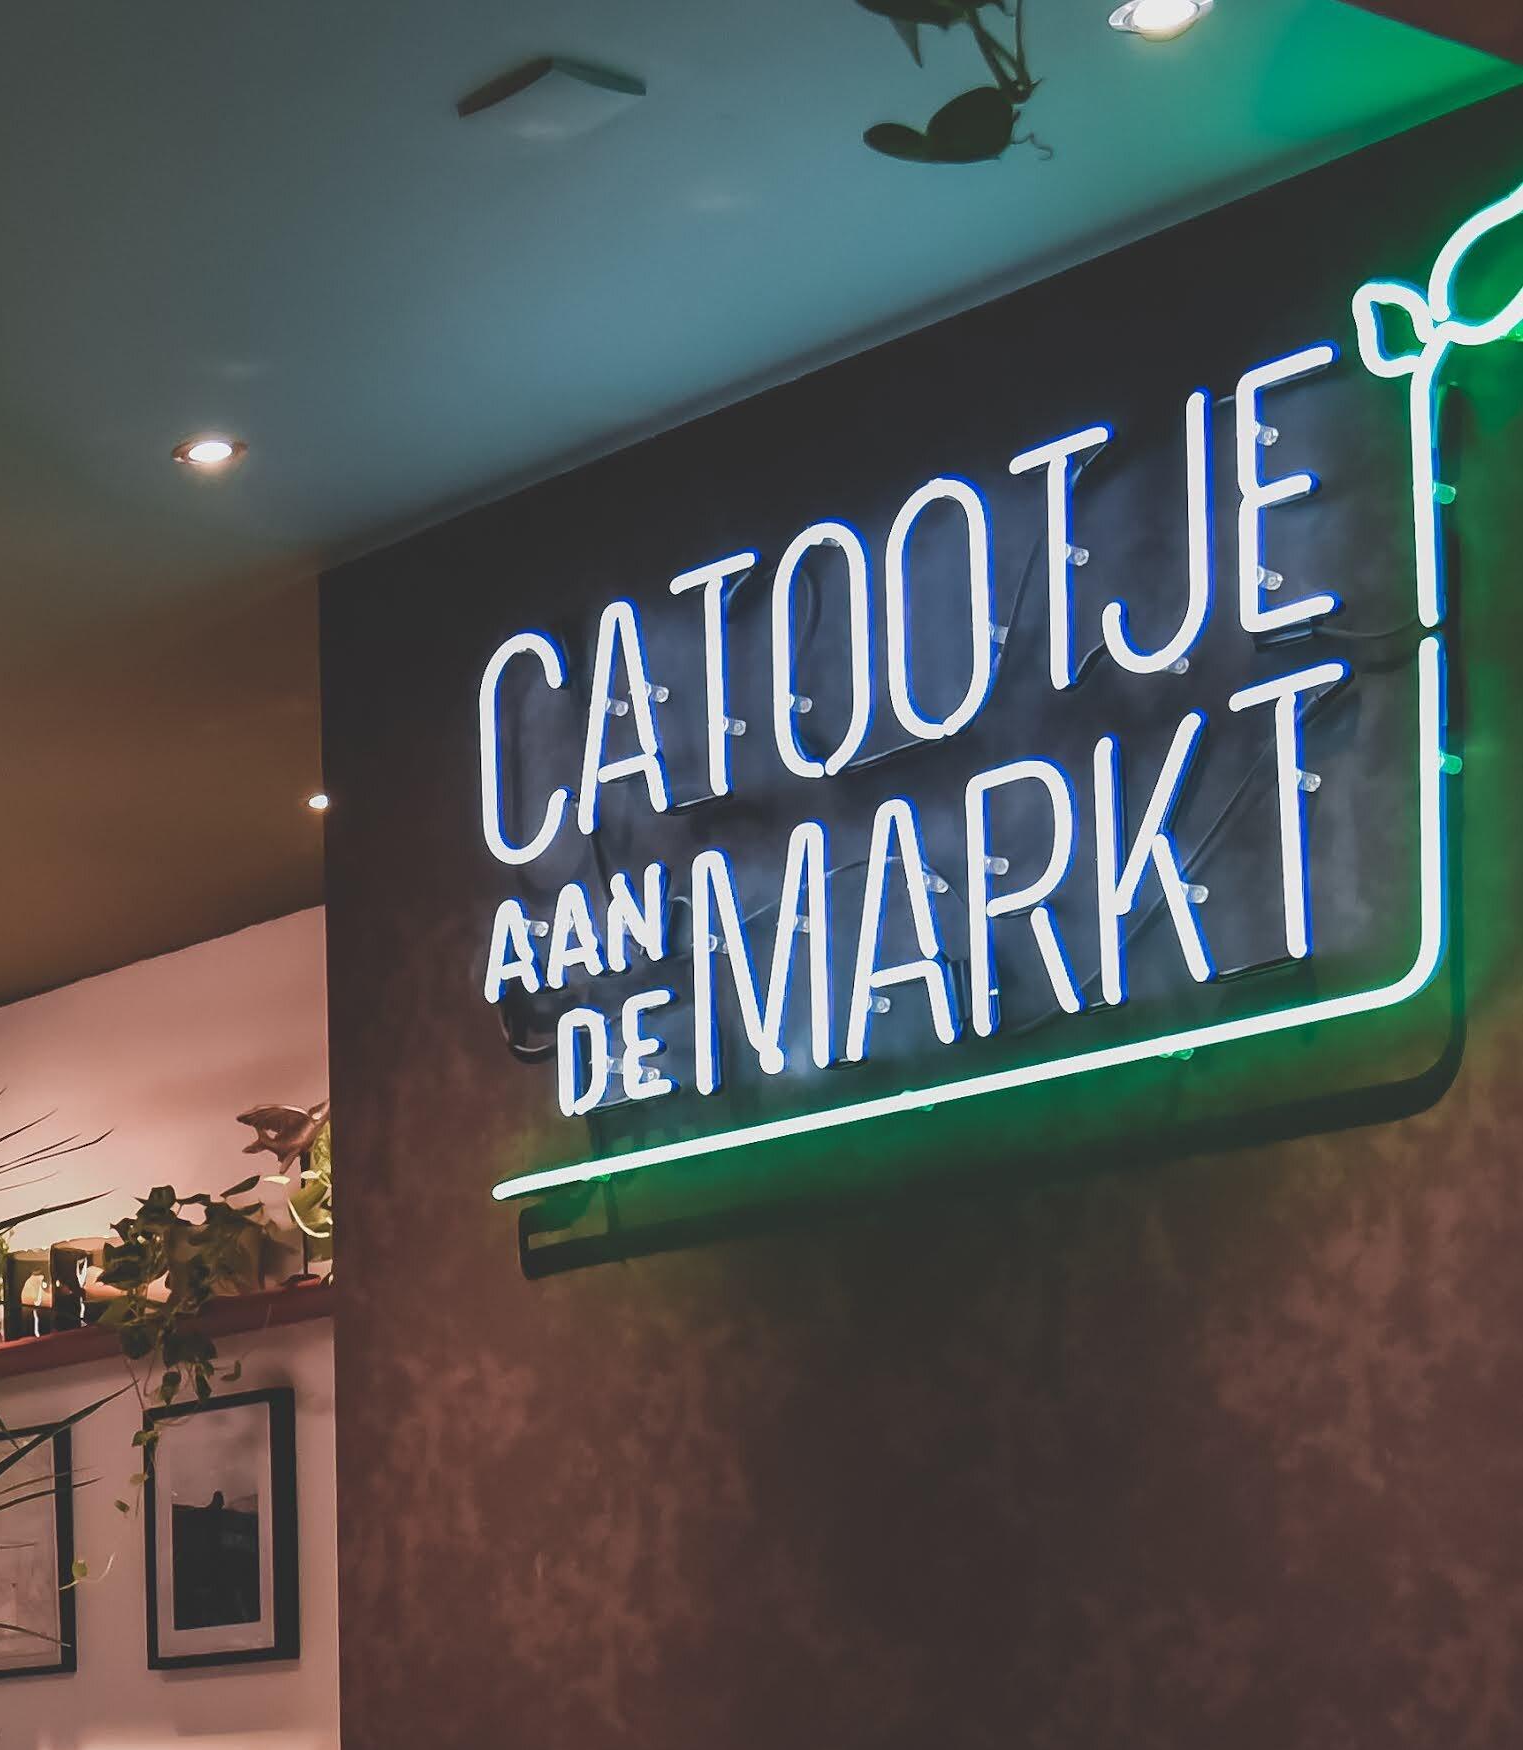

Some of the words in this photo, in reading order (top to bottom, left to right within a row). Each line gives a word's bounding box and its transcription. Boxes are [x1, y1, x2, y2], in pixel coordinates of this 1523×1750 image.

[479, 342, 1340, 866] CATOOTJE
[486, 863, 670, 1003] AAN
[690, 659, 1351, 1095] MARKT
[557, 988, 677, 1117] DE
